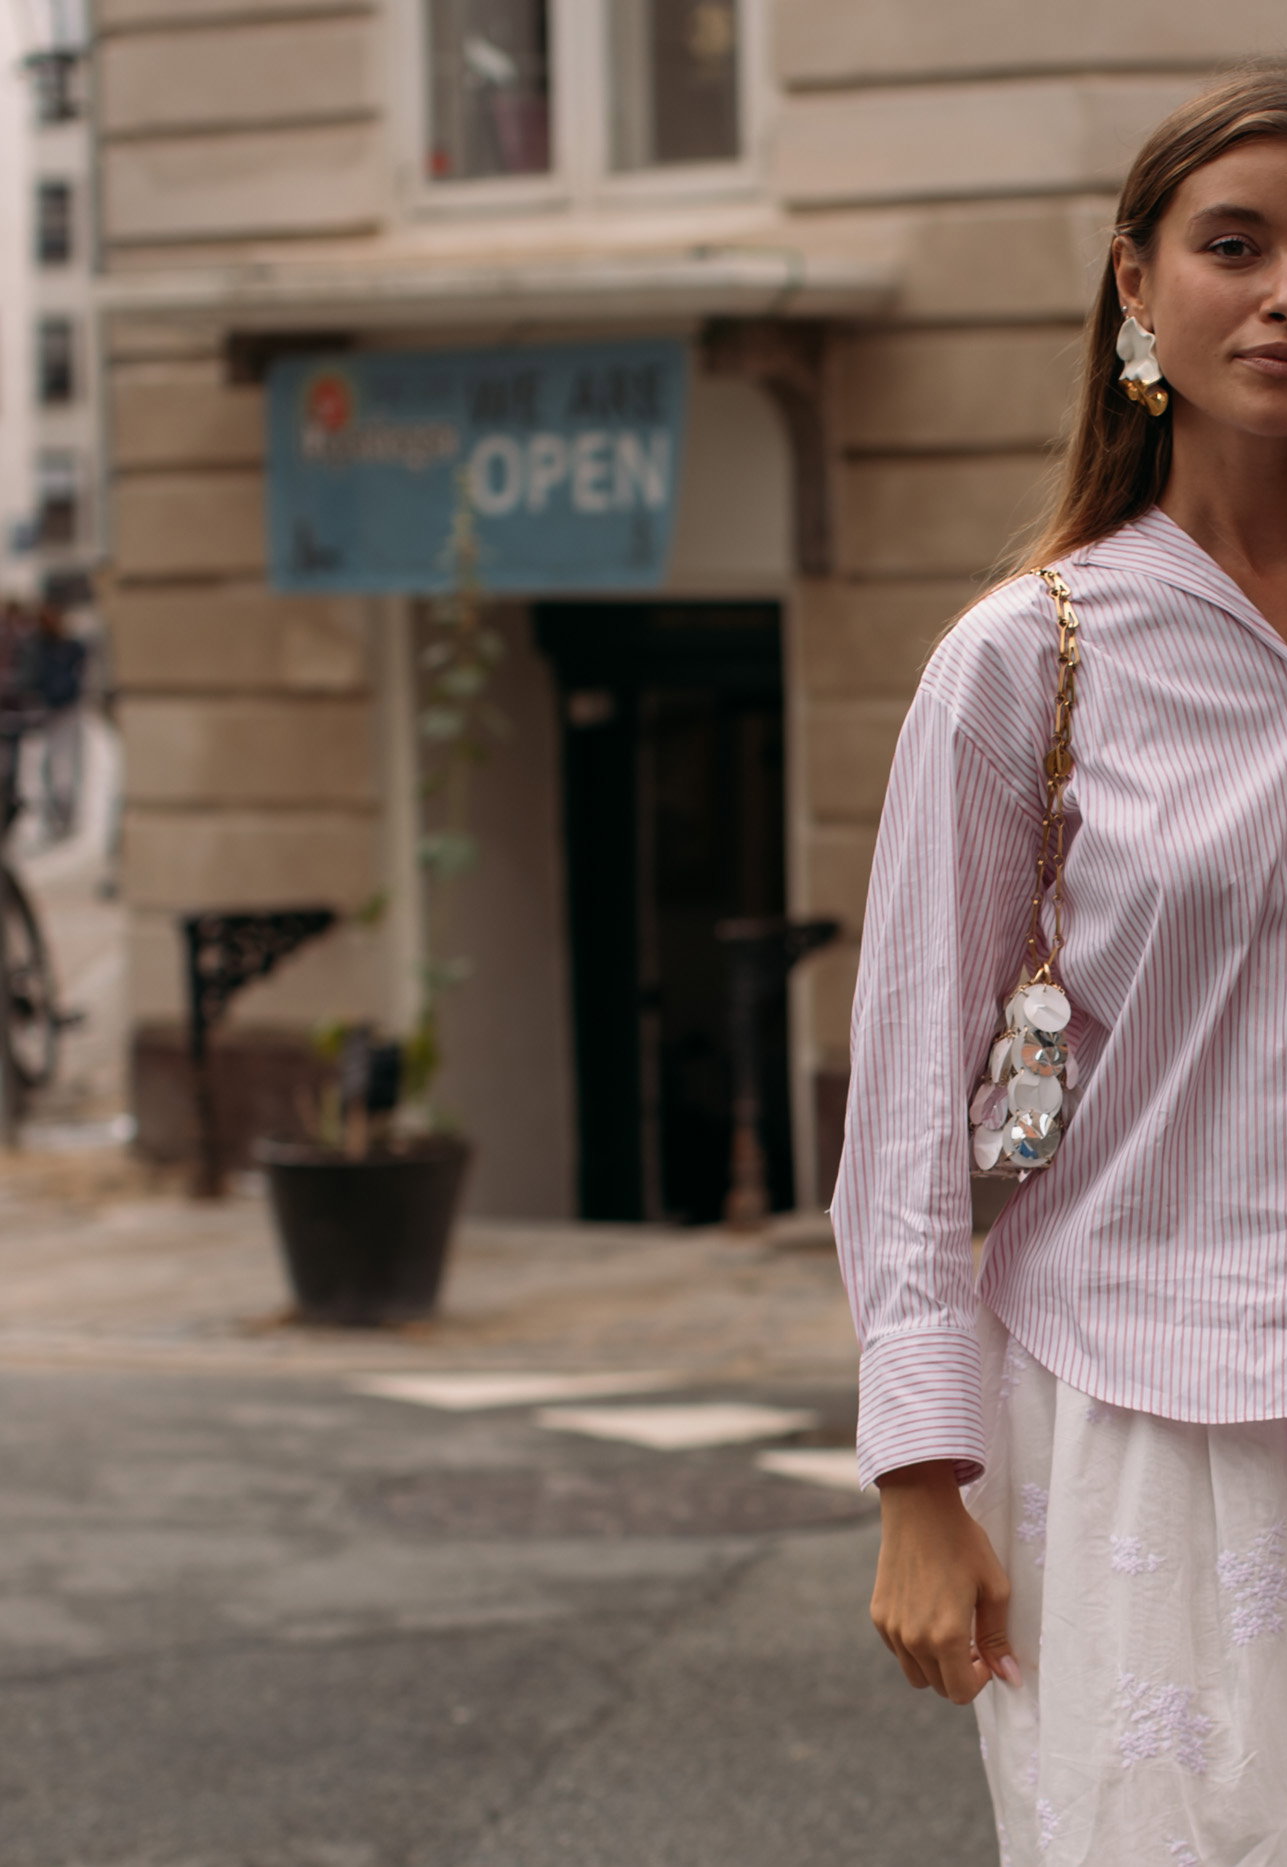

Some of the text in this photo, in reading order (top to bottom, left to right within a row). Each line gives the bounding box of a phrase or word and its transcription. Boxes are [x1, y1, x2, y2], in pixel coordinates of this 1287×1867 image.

[469, 360, 666, 428] WE ARE
[468, 432, 670, 516] OPEN
